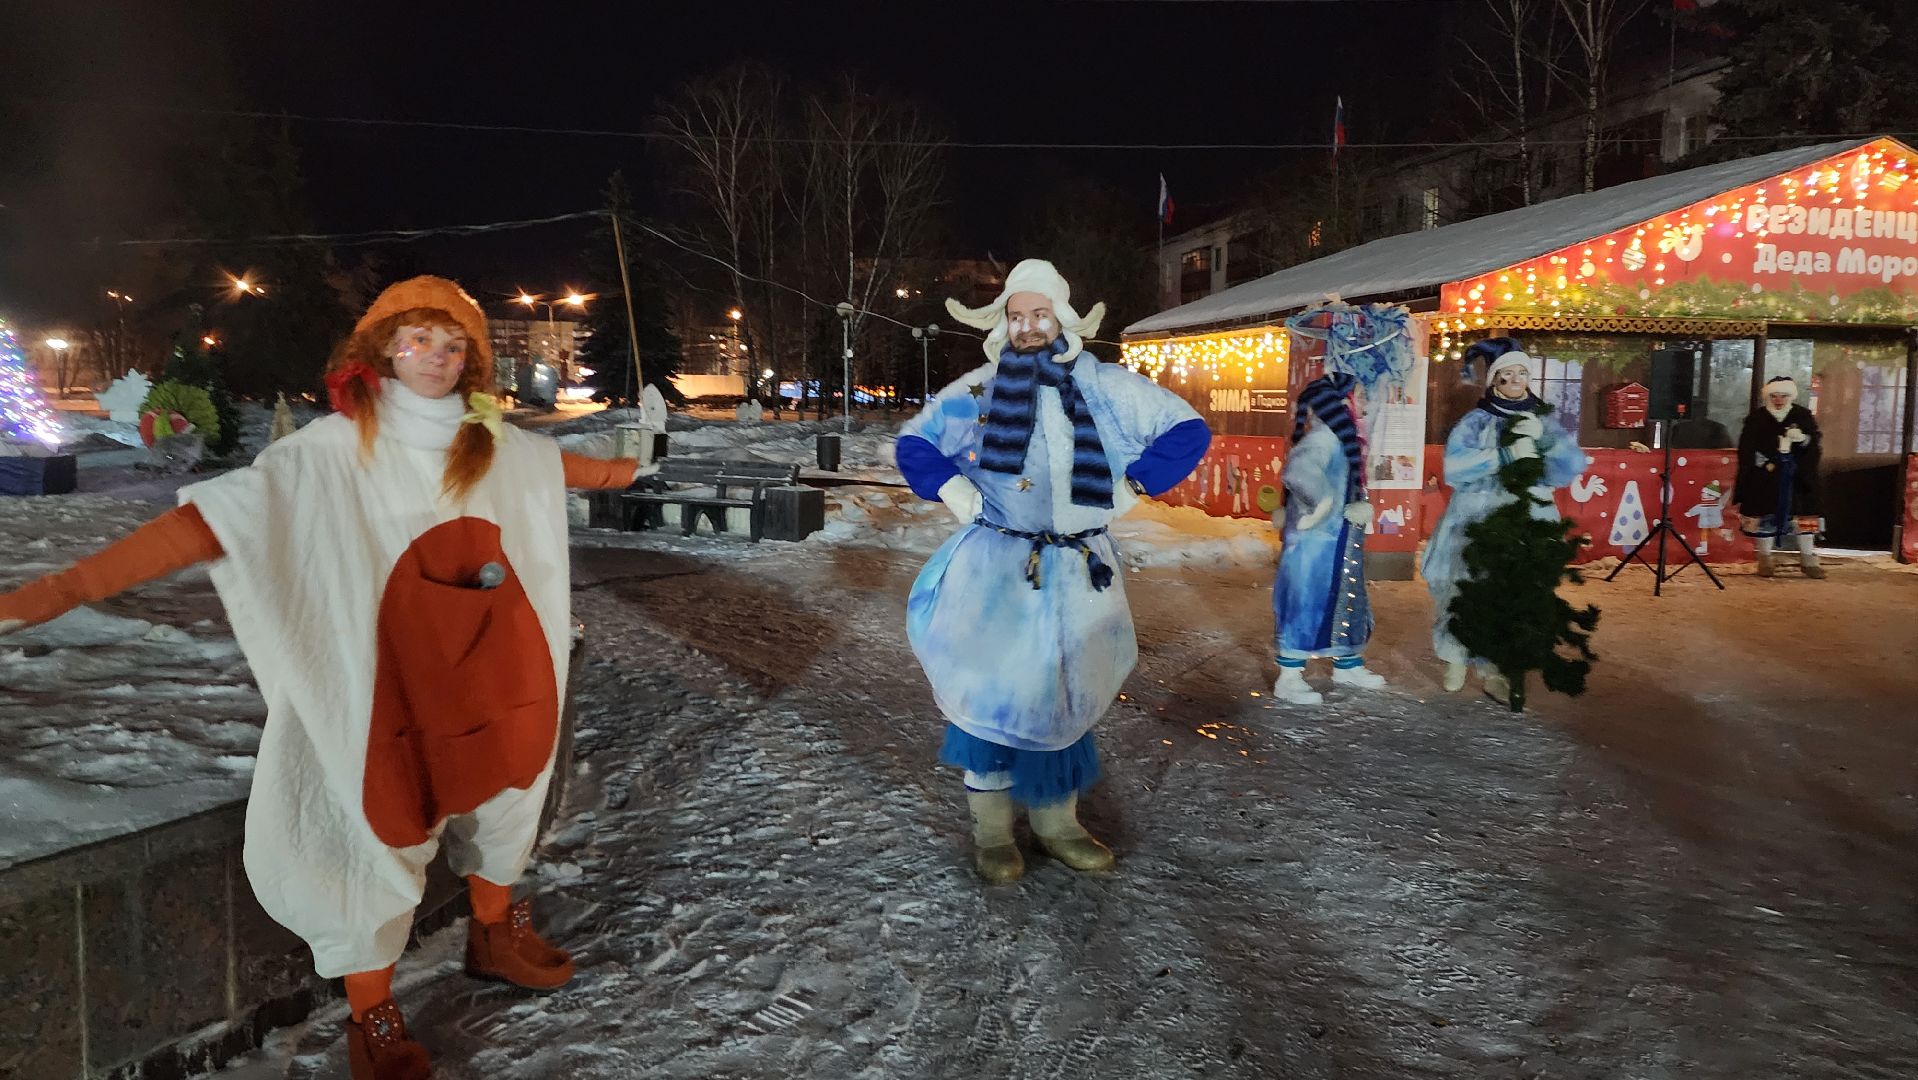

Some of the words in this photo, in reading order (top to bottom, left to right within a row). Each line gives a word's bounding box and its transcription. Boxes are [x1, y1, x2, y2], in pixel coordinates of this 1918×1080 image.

[1753, 244, 1831, 275] Деда
[1836, 247, 1918, 283] Моро
[1209, 388, 1250, 412] ЗИМА
